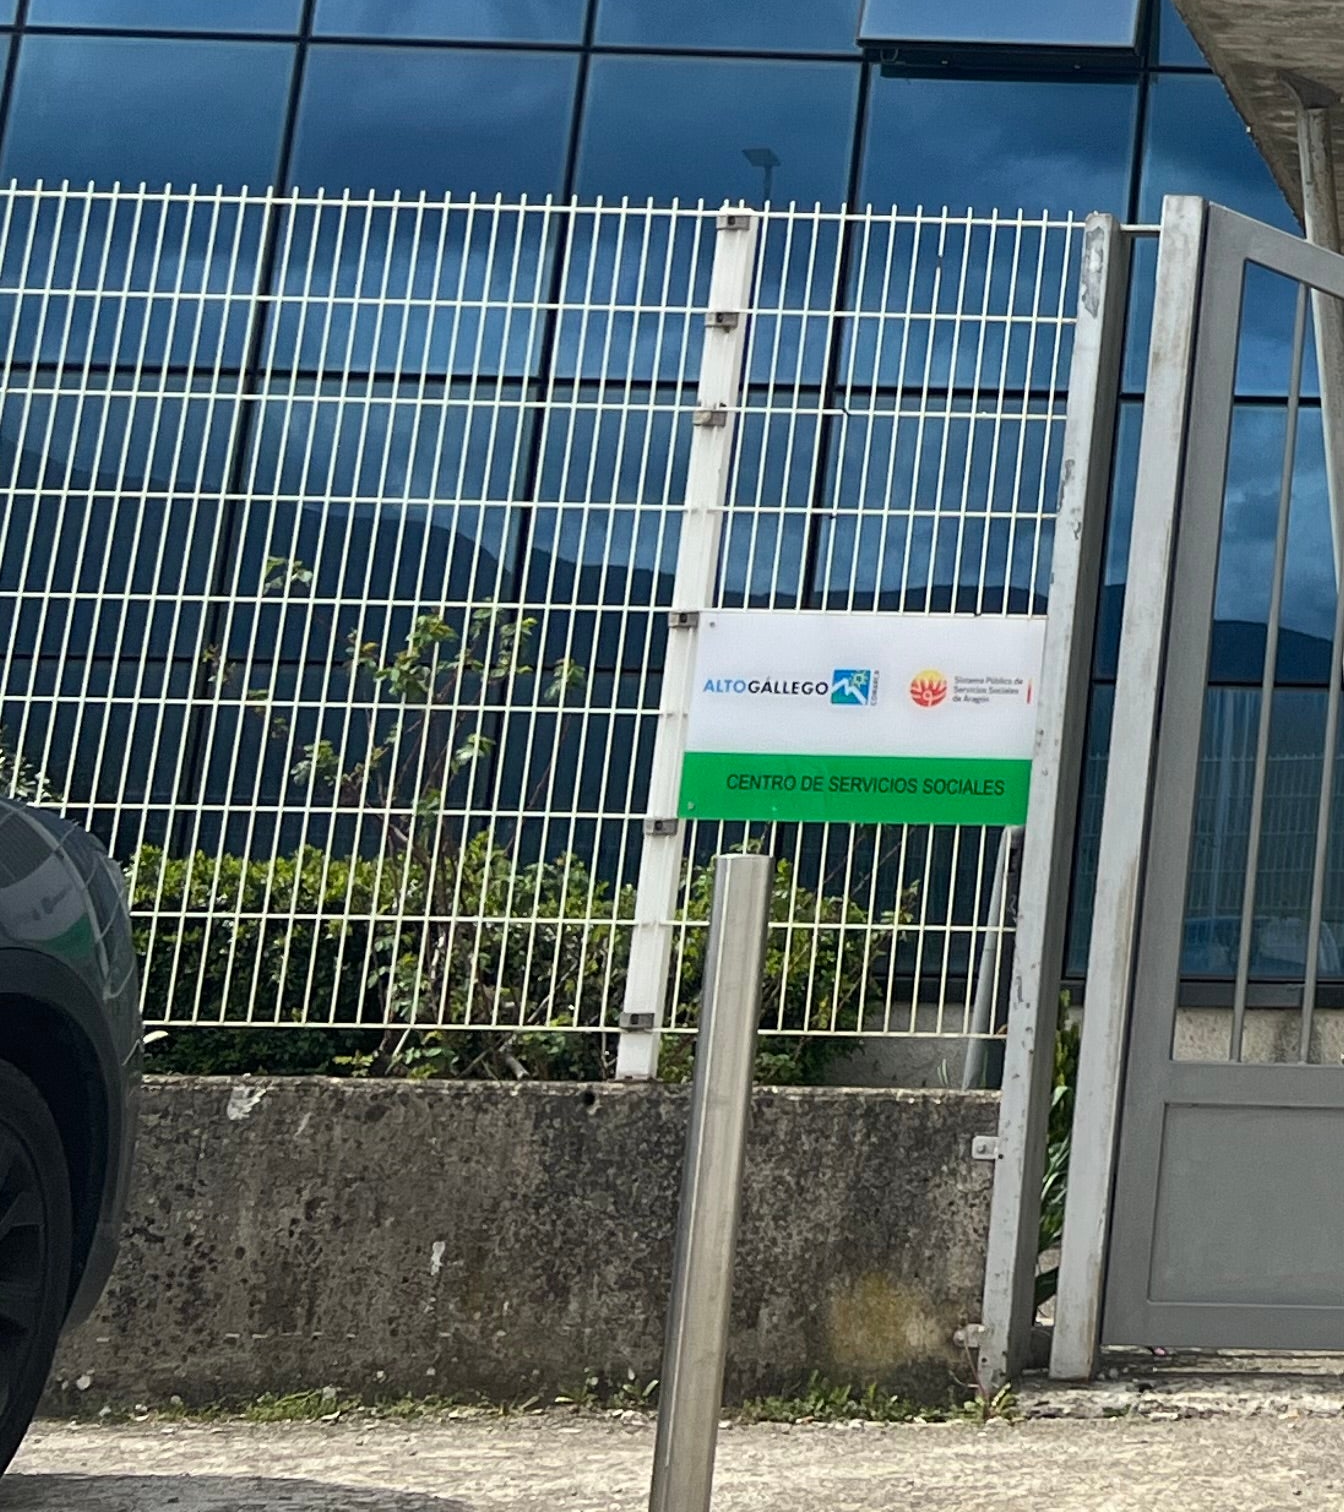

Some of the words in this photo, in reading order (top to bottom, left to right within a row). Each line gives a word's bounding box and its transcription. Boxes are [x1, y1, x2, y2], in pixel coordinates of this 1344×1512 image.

[726, 774, 796, 791] CENTRO
[800, 775, 824, 792] DE
[829, 776, 917, 794] SERVICIOS
[923, 778, 1005, 795] SOCIALES
